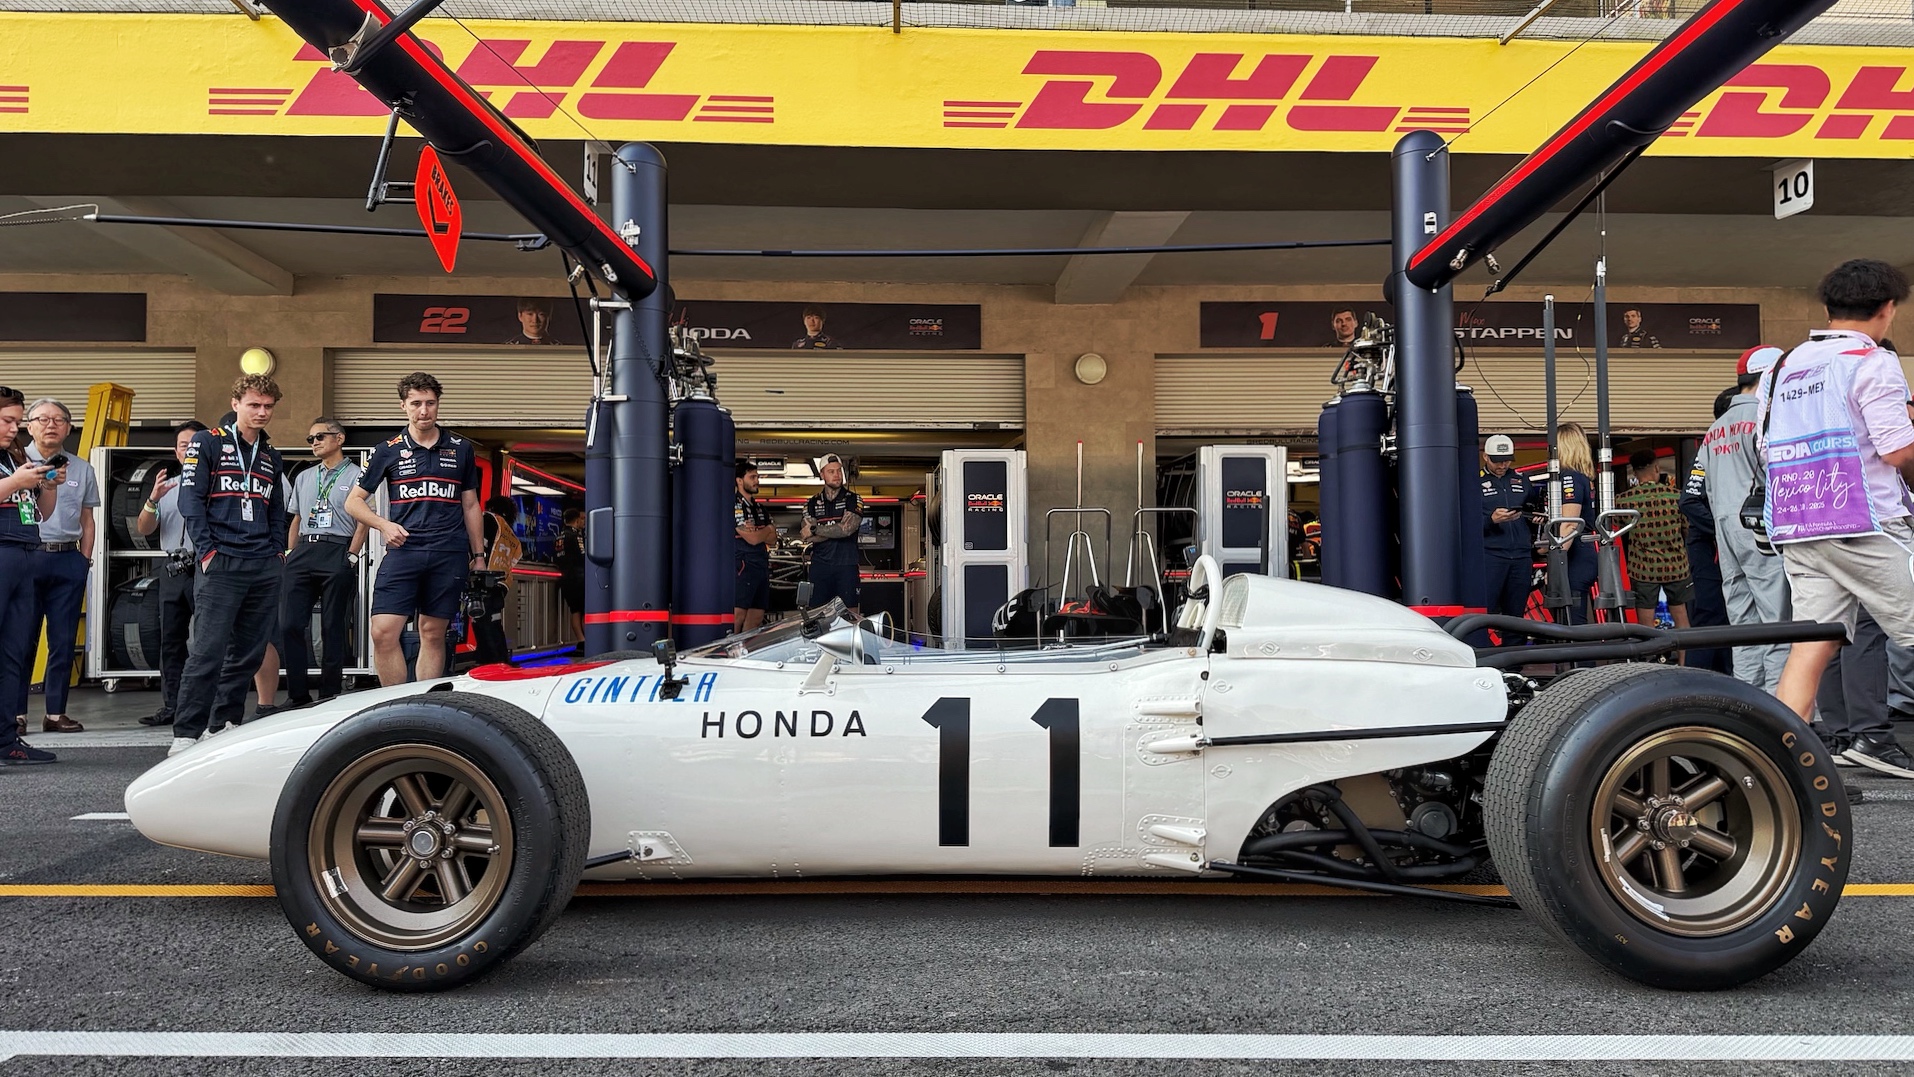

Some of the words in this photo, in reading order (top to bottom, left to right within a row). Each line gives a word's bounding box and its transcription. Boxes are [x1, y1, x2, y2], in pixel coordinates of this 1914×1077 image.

[1015, 51, 1380, 132] DHL
[1778, 171, 1809, 205] 10
[419, 307, 471, 333] 22
[1259, 312, 1279, 339] 1
[1779, 379, 1826, 403] 1429-MEX
[220, 476, 250, 491] Red
[399, 481, 427, 498] Red
[428, 481, 455, 498] Bull
[1815, 462, 1856, 510] City
[702, 711, 867, 739] HONDA
[922, 698, 1081, 847] 11
[1775, 731, 1842, 945] GOODYEAR
[306, 921, 489, 981] GOODYEAR
